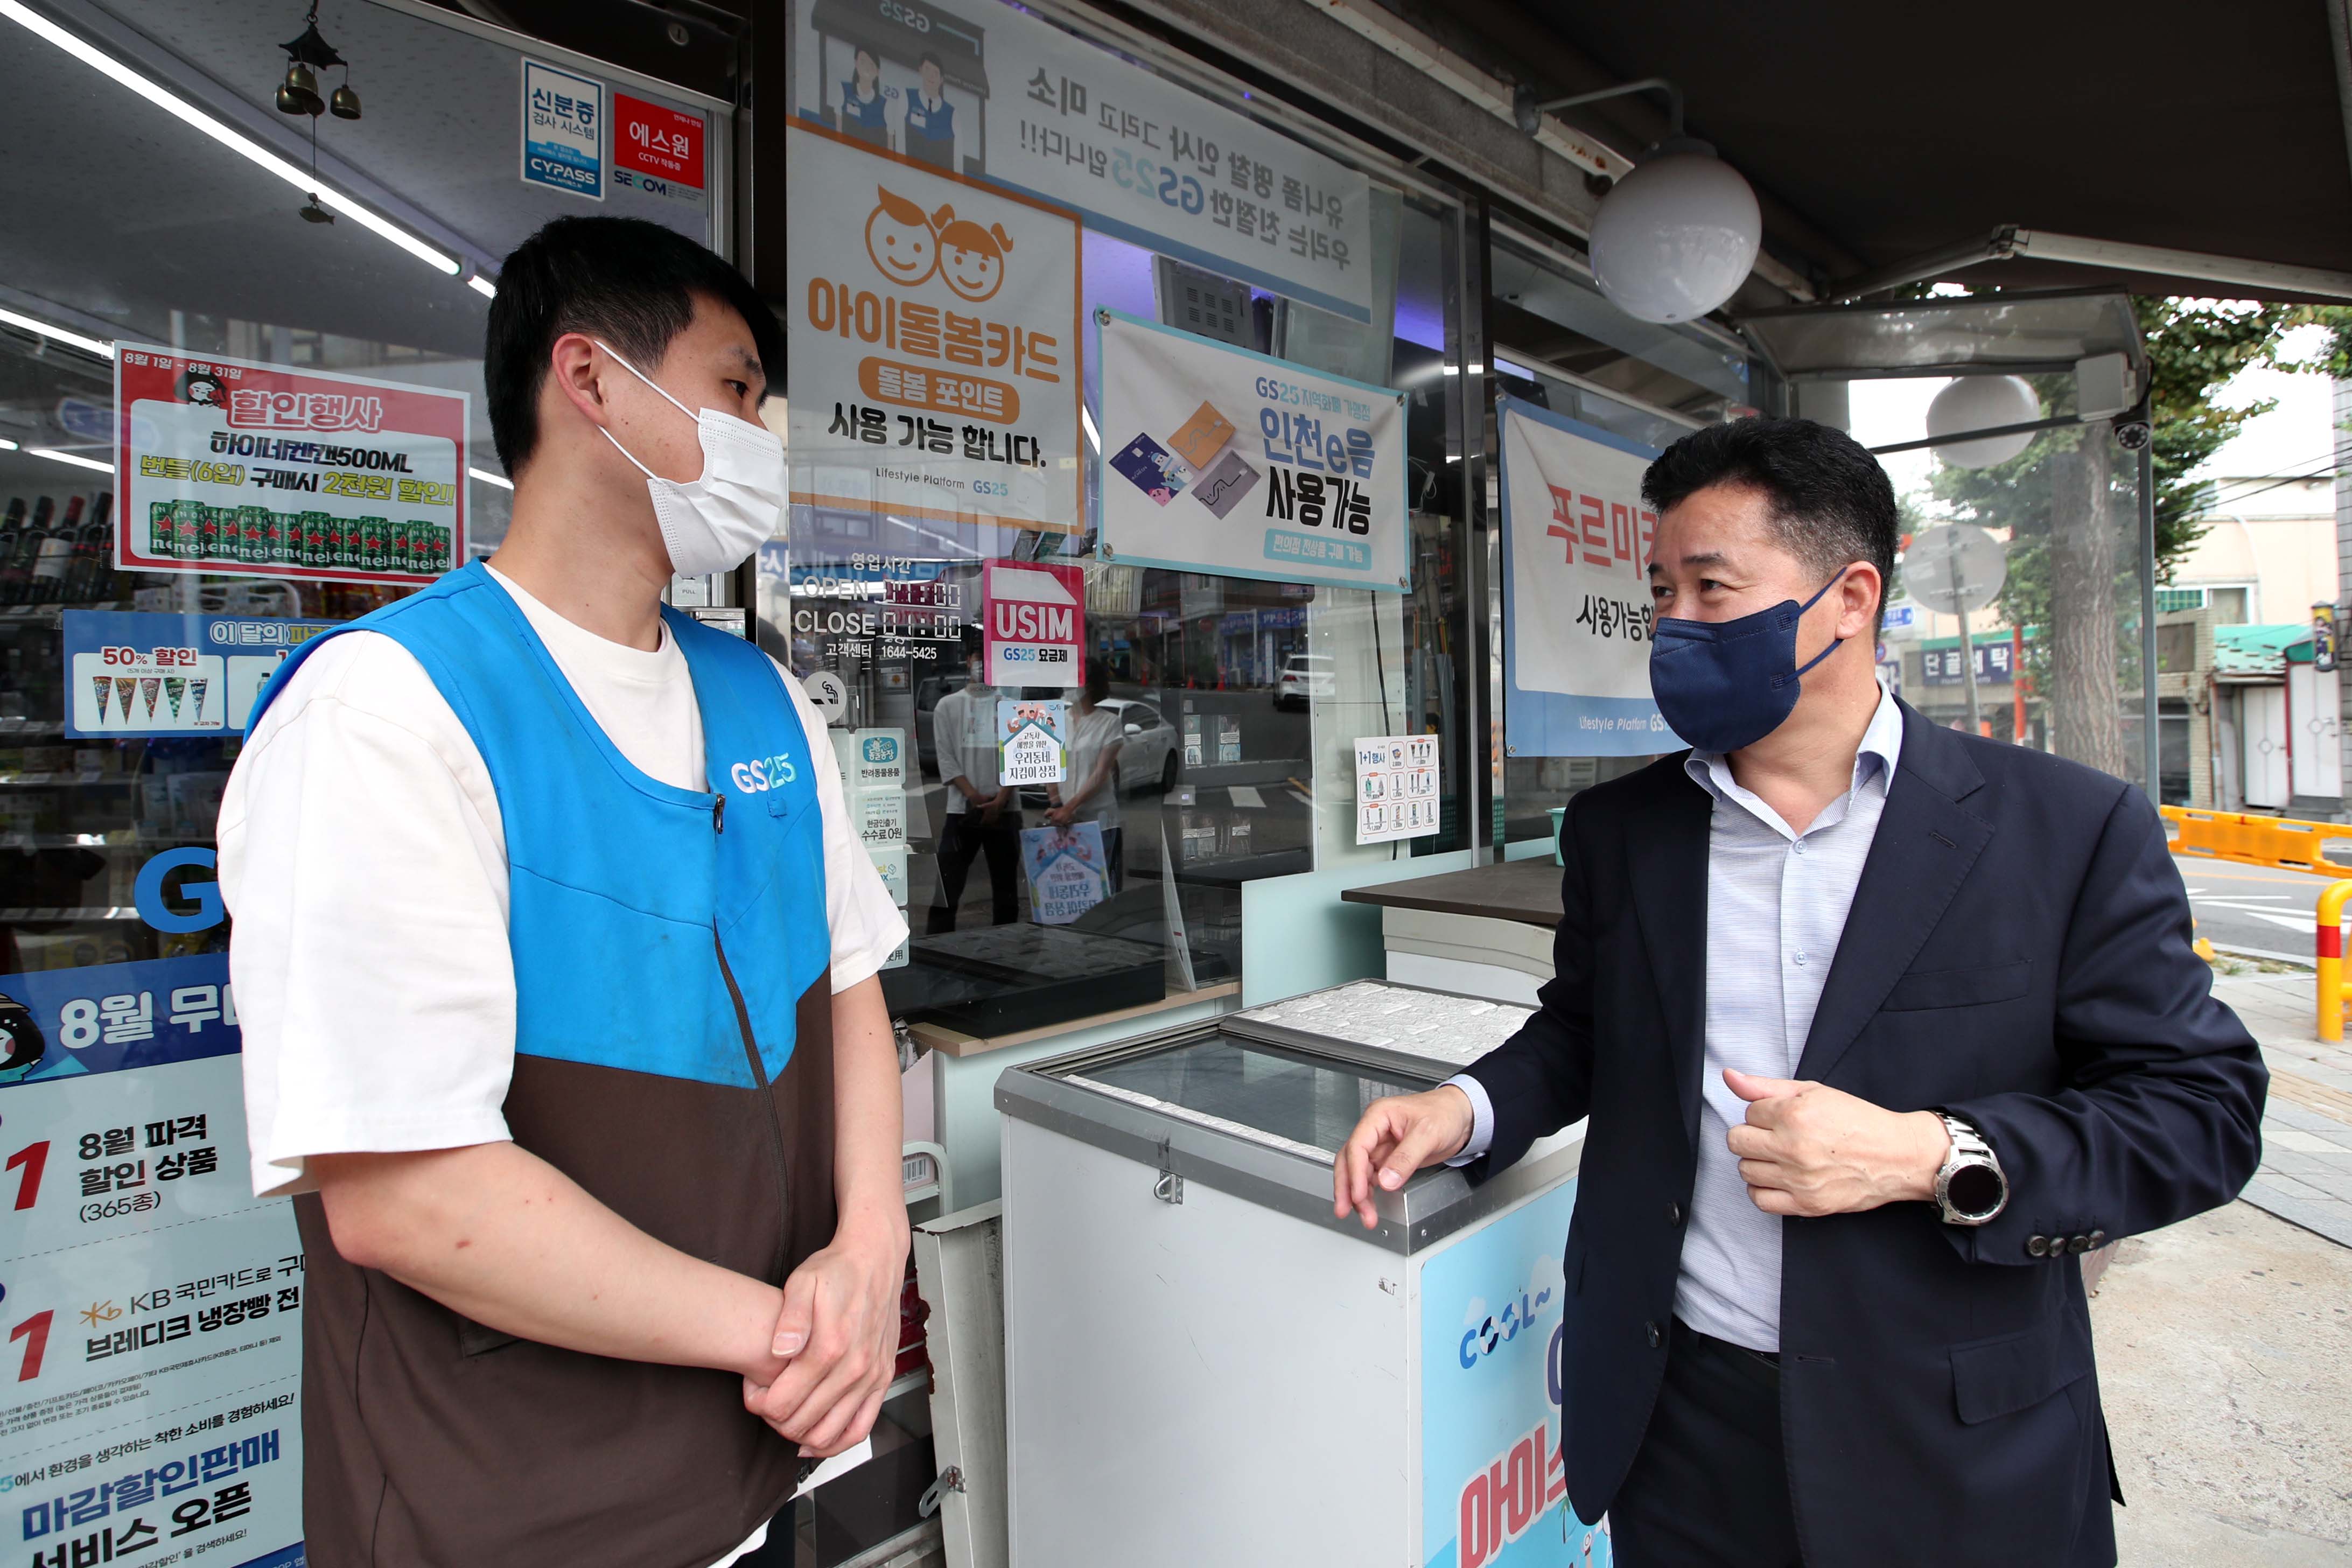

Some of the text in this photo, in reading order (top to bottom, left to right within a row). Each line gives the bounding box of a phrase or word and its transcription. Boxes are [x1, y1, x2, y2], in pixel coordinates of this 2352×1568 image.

[533, 87, 594, 124] 신분증
[533, 112, 594, 140] 검사 시스템
[629, 121, 689, 159] 에스원
[531, 158, 595, 185] CYPASS
[638, 152, 660, 164] CCTV
[614, 170, 667, 195] SECOM
[808, 277, 1060, 383] 아이돌봄카드
[124, 352, 149, 367] 8월
[152, 355, 173, 370] 1일
[188, 362, 212, 376] 8월
[214, 364, 242, 380] 31일
[878, 365, 1003, 416] 돌봄 포인트
[1256, 377, 1299, 405] GS25
[1301, 388, 1341, 414] 지역화폐
[230, 390, 382, 430] 할인행사
[828, 402, 1047, 468] 사용 가능 합니다.
[1260, 407, 1375, 479] 인천e음
[140, 454, 245, 486] 번들(6입)
[249, 466, 319, 493] 구매시
[323, 472, 393, 500] 2천원
[876, 467, 1008, 496] Lifestyle Platform GS25
[1266, 466, 1370, 535] 사용가능
[851, 552, 911, 573] 영업시간
[1273, 534, 1301, 555] 편의점
[1347, 545, 1363, 563] 가능
[803, 576, 869, 601] OPEN
[213, 624, 234, 643] 이
[241, 625, 283, 643] 달의
[794, 610, 876, 635] CLOSE
[996, 604, 1073, 641] USIM
[103, 648, 198, 667] 50% 할인
[825, 643, 937, 660] 고객센터 1644-5425
[1003, 647, 1068, 663] GS25 요금제
[1024, 732, 1040, 740] 고독사
[1579, 716, 1613, 733] Lifestyle
[1617, 717, 1647, 731] Platform
[869, 749, 894, 760] 동물농장
[1015, 751, 1051, 765] 우리동네
[1017, 741, 1034, 749] 예방을
[1359, 751, 1385, 765] 1+1행사
[731, 752, 797, 794] GS25
[862, 768, 900, 778] 반려동물용품
[1009, 765, 1056, 779] 지킴이 상점
[862, 828, 902, 841] 수수료 0원
[867, 818, 897, 828] 현금인출기
[60, 991, 155, 1049] 8월
[5, 1114, 207, 1212] 1 8월 파격
[79, 1146, 218, 1197] 할인 상품
[79, 1191, 161, 1223] (365종)
[277, 1254, 305, 1277] 구
[86, 1286, 300, 1362] 브레디크 냉장빵 전
[9, 1309, 54, 1382] 1
[75, 1407, 89, 1416] 조기
[48, 1453, 92, 1478] 환경을
[95, 1438, 152, 1465] 생각하는
[155, 1426, 183, 1445] 착한
[185, 1413, 225, 1436] 소비를
[227, 1392, 295, 1423] 경험하세요!
[22, 1428, 280, 1541] 마감할인판매
[31, 1481, 252, 1568] 서비스 오픈
[196, 1528, 247, 1553] 검색하세요!
